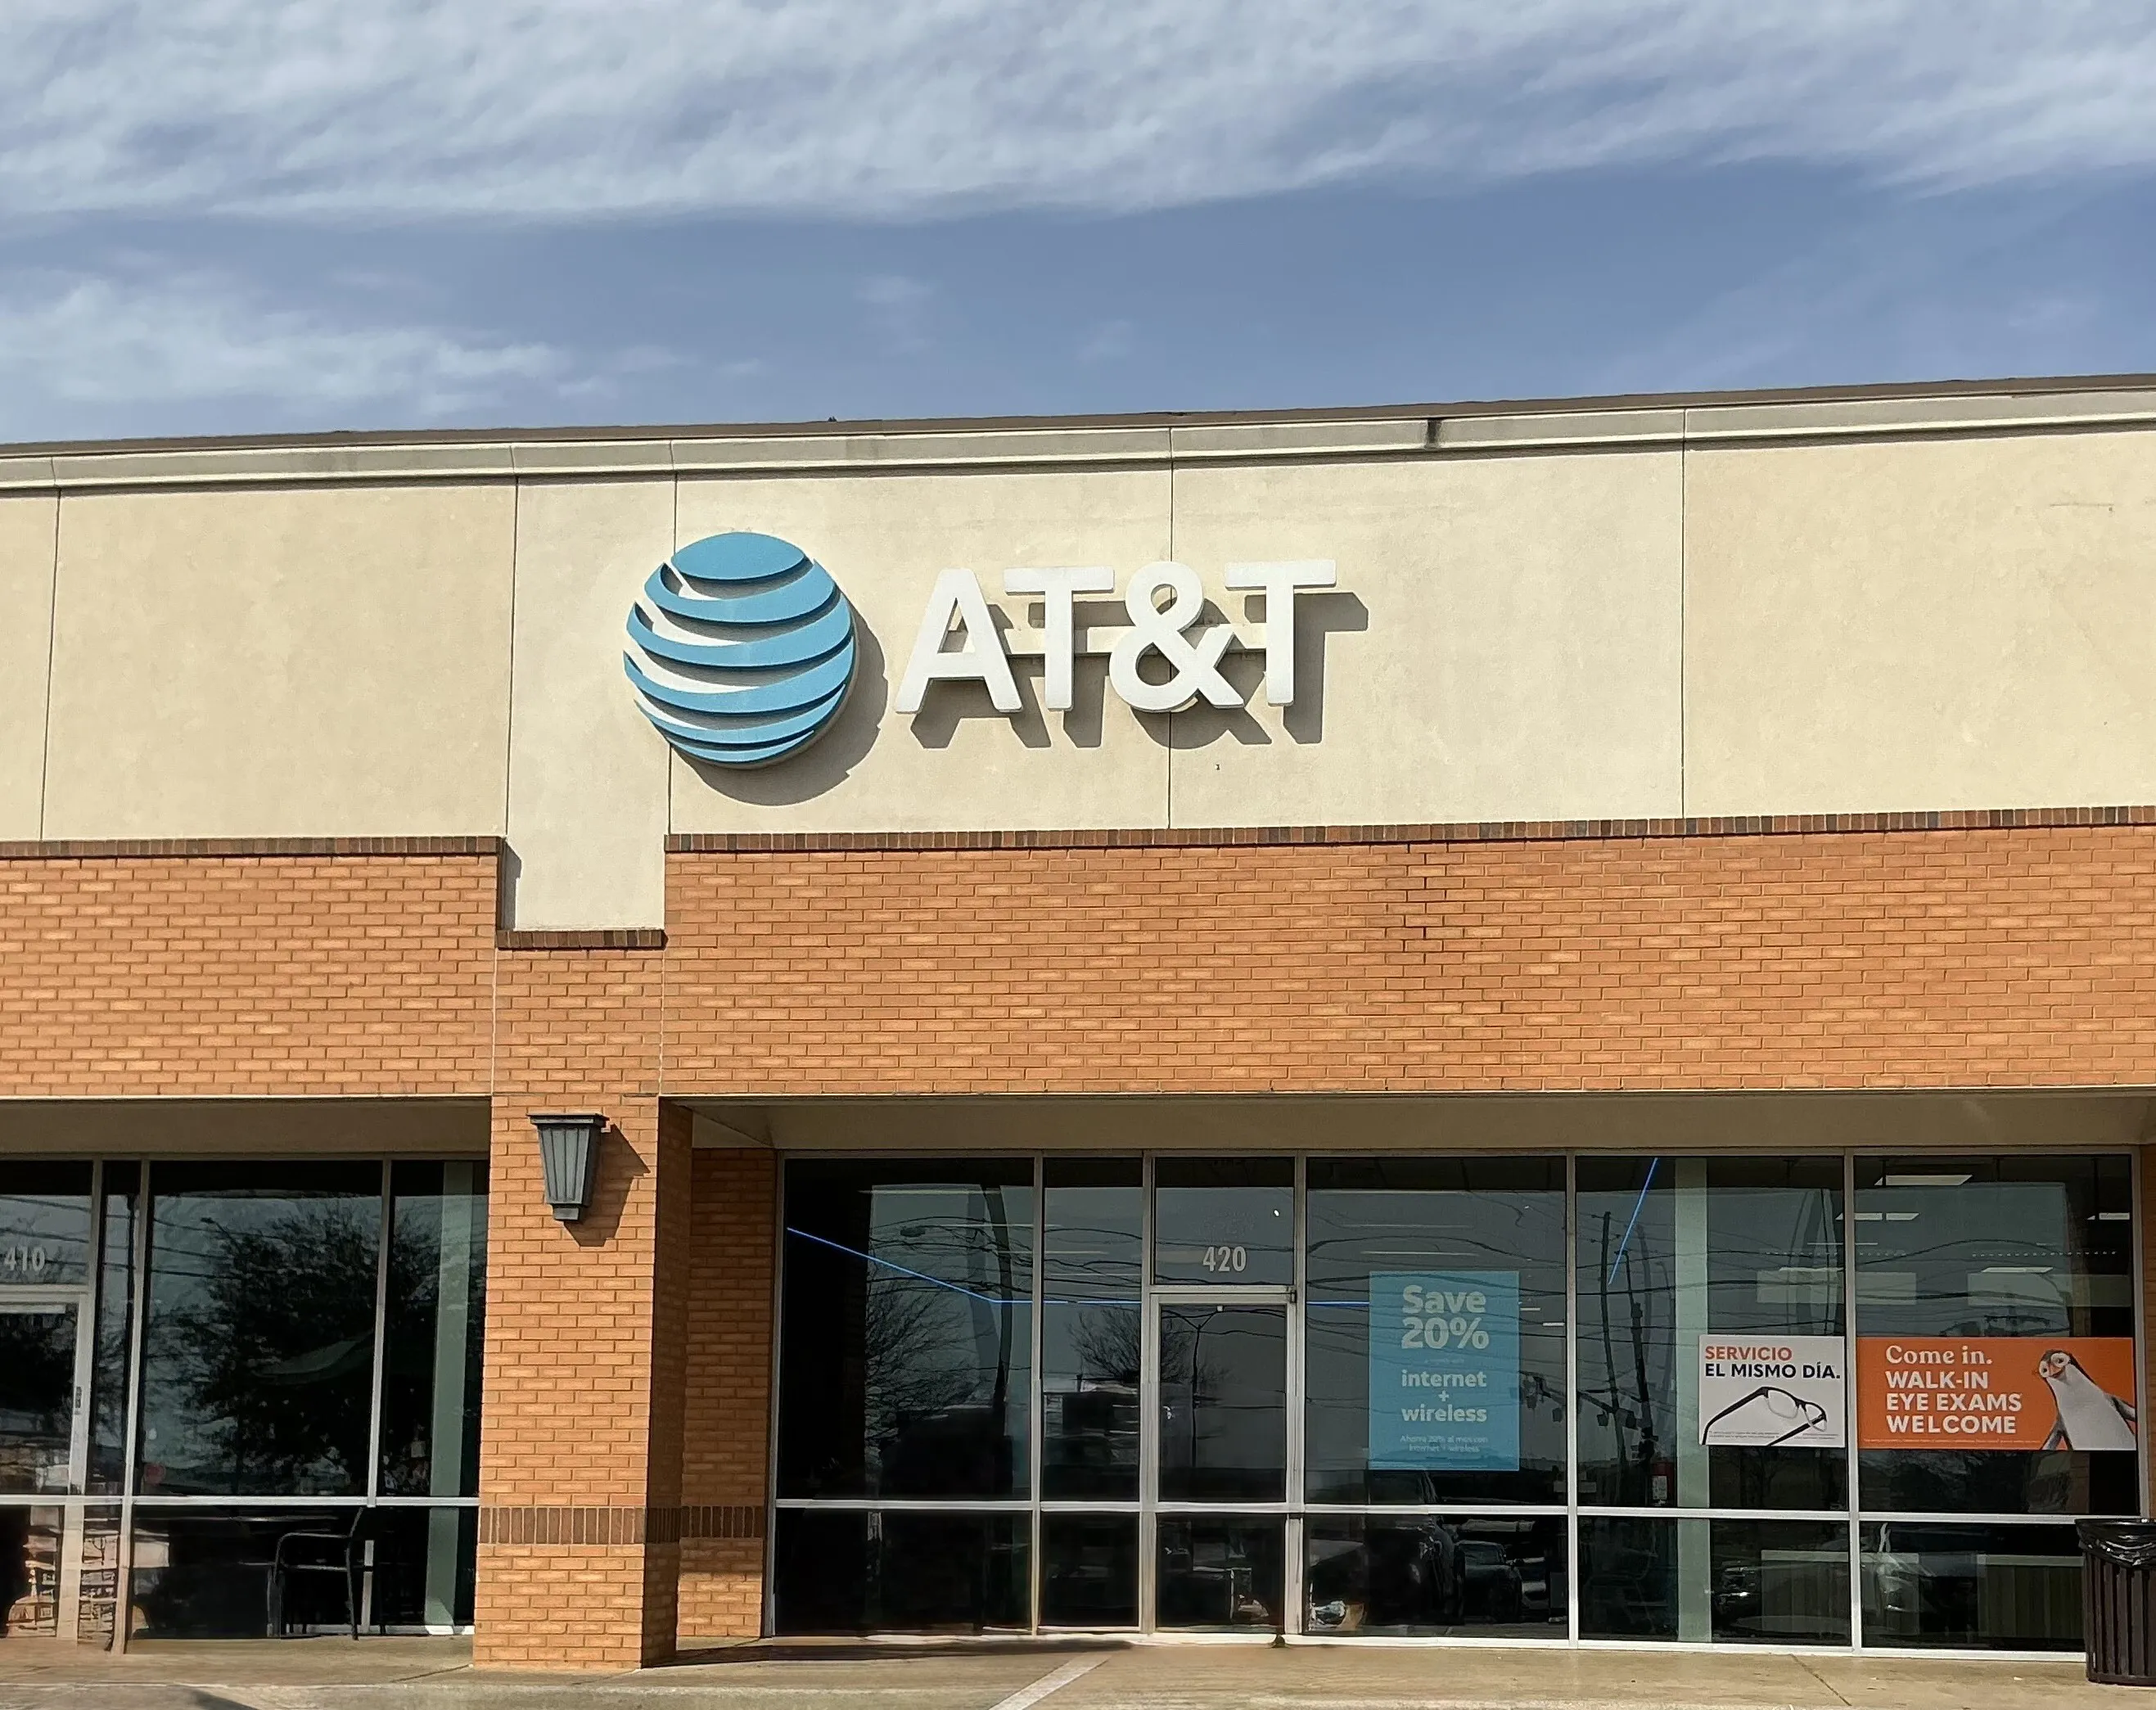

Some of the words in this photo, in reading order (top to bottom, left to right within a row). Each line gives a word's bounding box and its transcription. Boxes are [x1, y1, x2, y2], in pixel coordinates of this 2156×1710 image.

[895, 560, 1337, 714] AT&T
[3, 1245, 45, 1271] 410
[1202, 1245, 1247, 1272] 420
[1402, 1284, 1486, 1314] Save
[1400, 1316, 1490, 1350] 20%
[1705, 1345, 1793, 1361] SERVICIO
[1885, 1345, 1955, 1365] Come
[1961, 1345, 1993, 1365] in.
[1400, 1369, 1487, 1387] internet
[1705, 1363, 1725, 1377] EL
[1731, 1363, 1797, 1378] MISMO
[1802, 1361, 1841, 1379] DÍA.
[1885, 1370, 1988, 1390] WALK-IN
[1400, 1403, 1487, 1422] wireless
[1886, 1393, 1928, 1411] EYE
[1937, 1393, 2023, 1412] EXAMS
[1886, 1414, 2017, 1433] WELCOME
